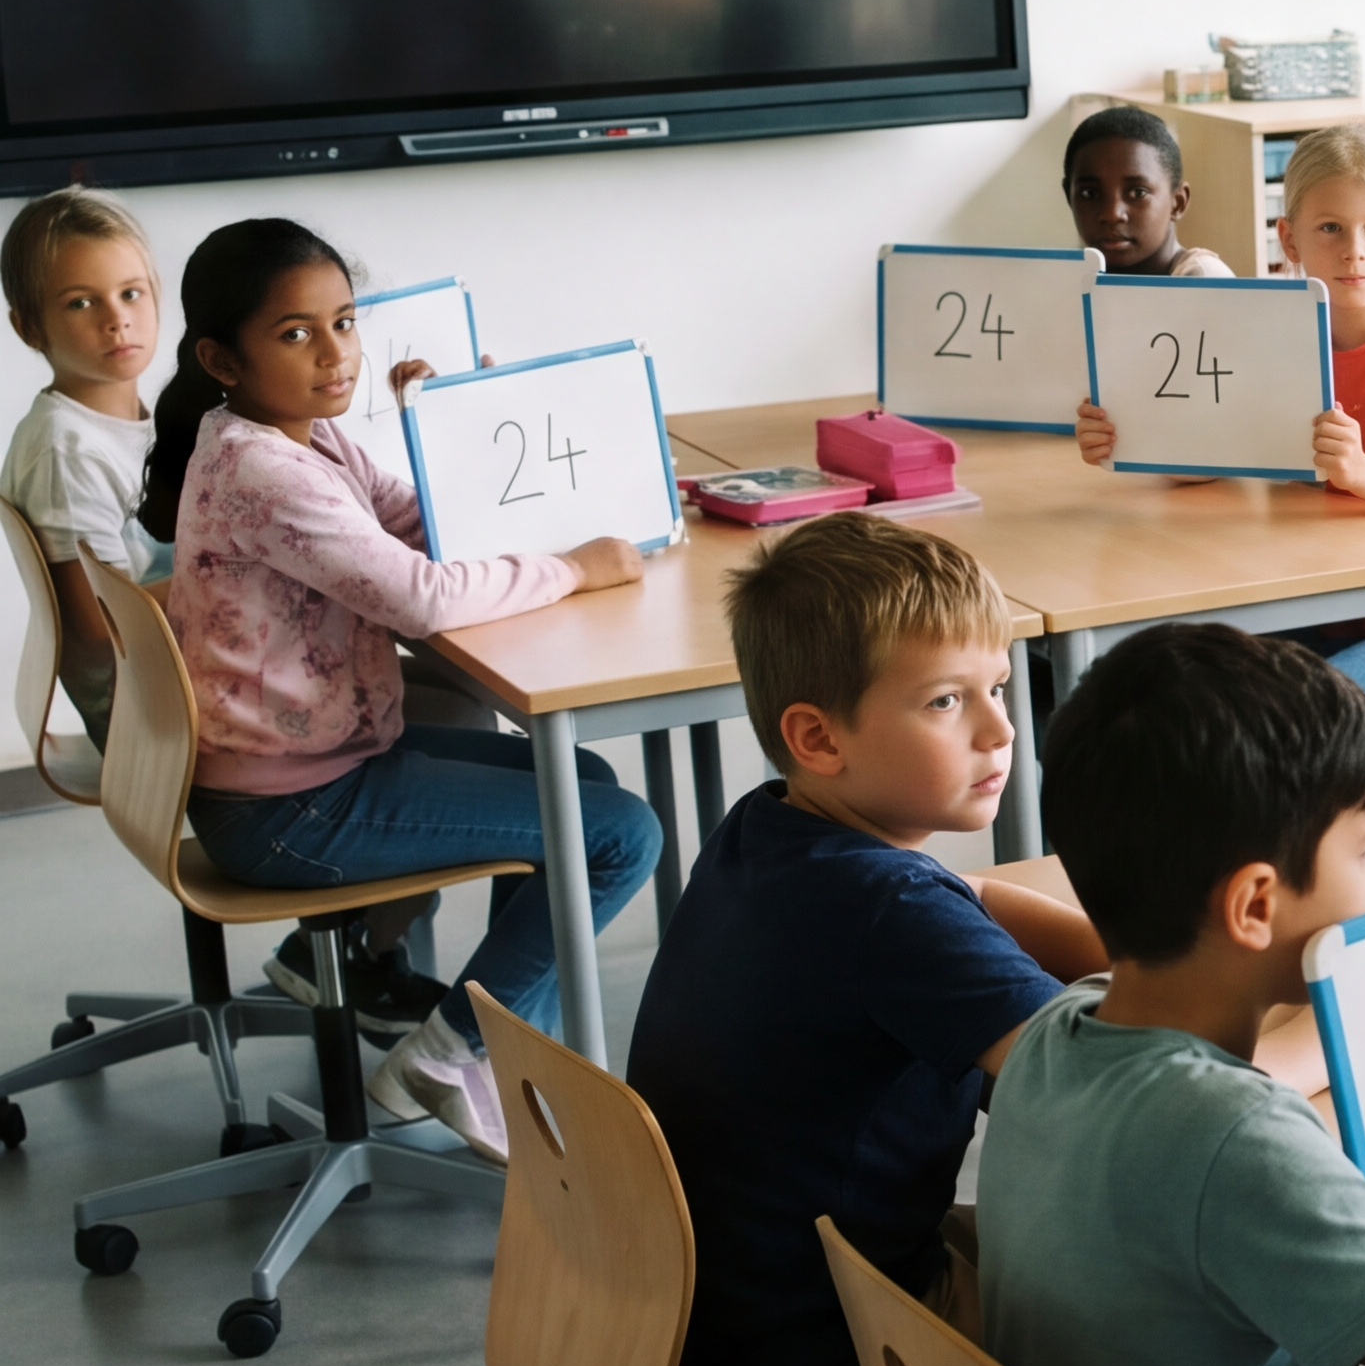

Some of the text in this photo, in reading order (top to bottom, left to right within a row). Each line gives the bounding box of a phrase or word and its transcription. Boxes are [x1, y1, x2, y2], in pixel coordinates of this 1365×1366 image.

[933, 290, 1015, 362] 24
[1150, 330, 1234, 404] 24
[493, 412, 588, 507] 24
